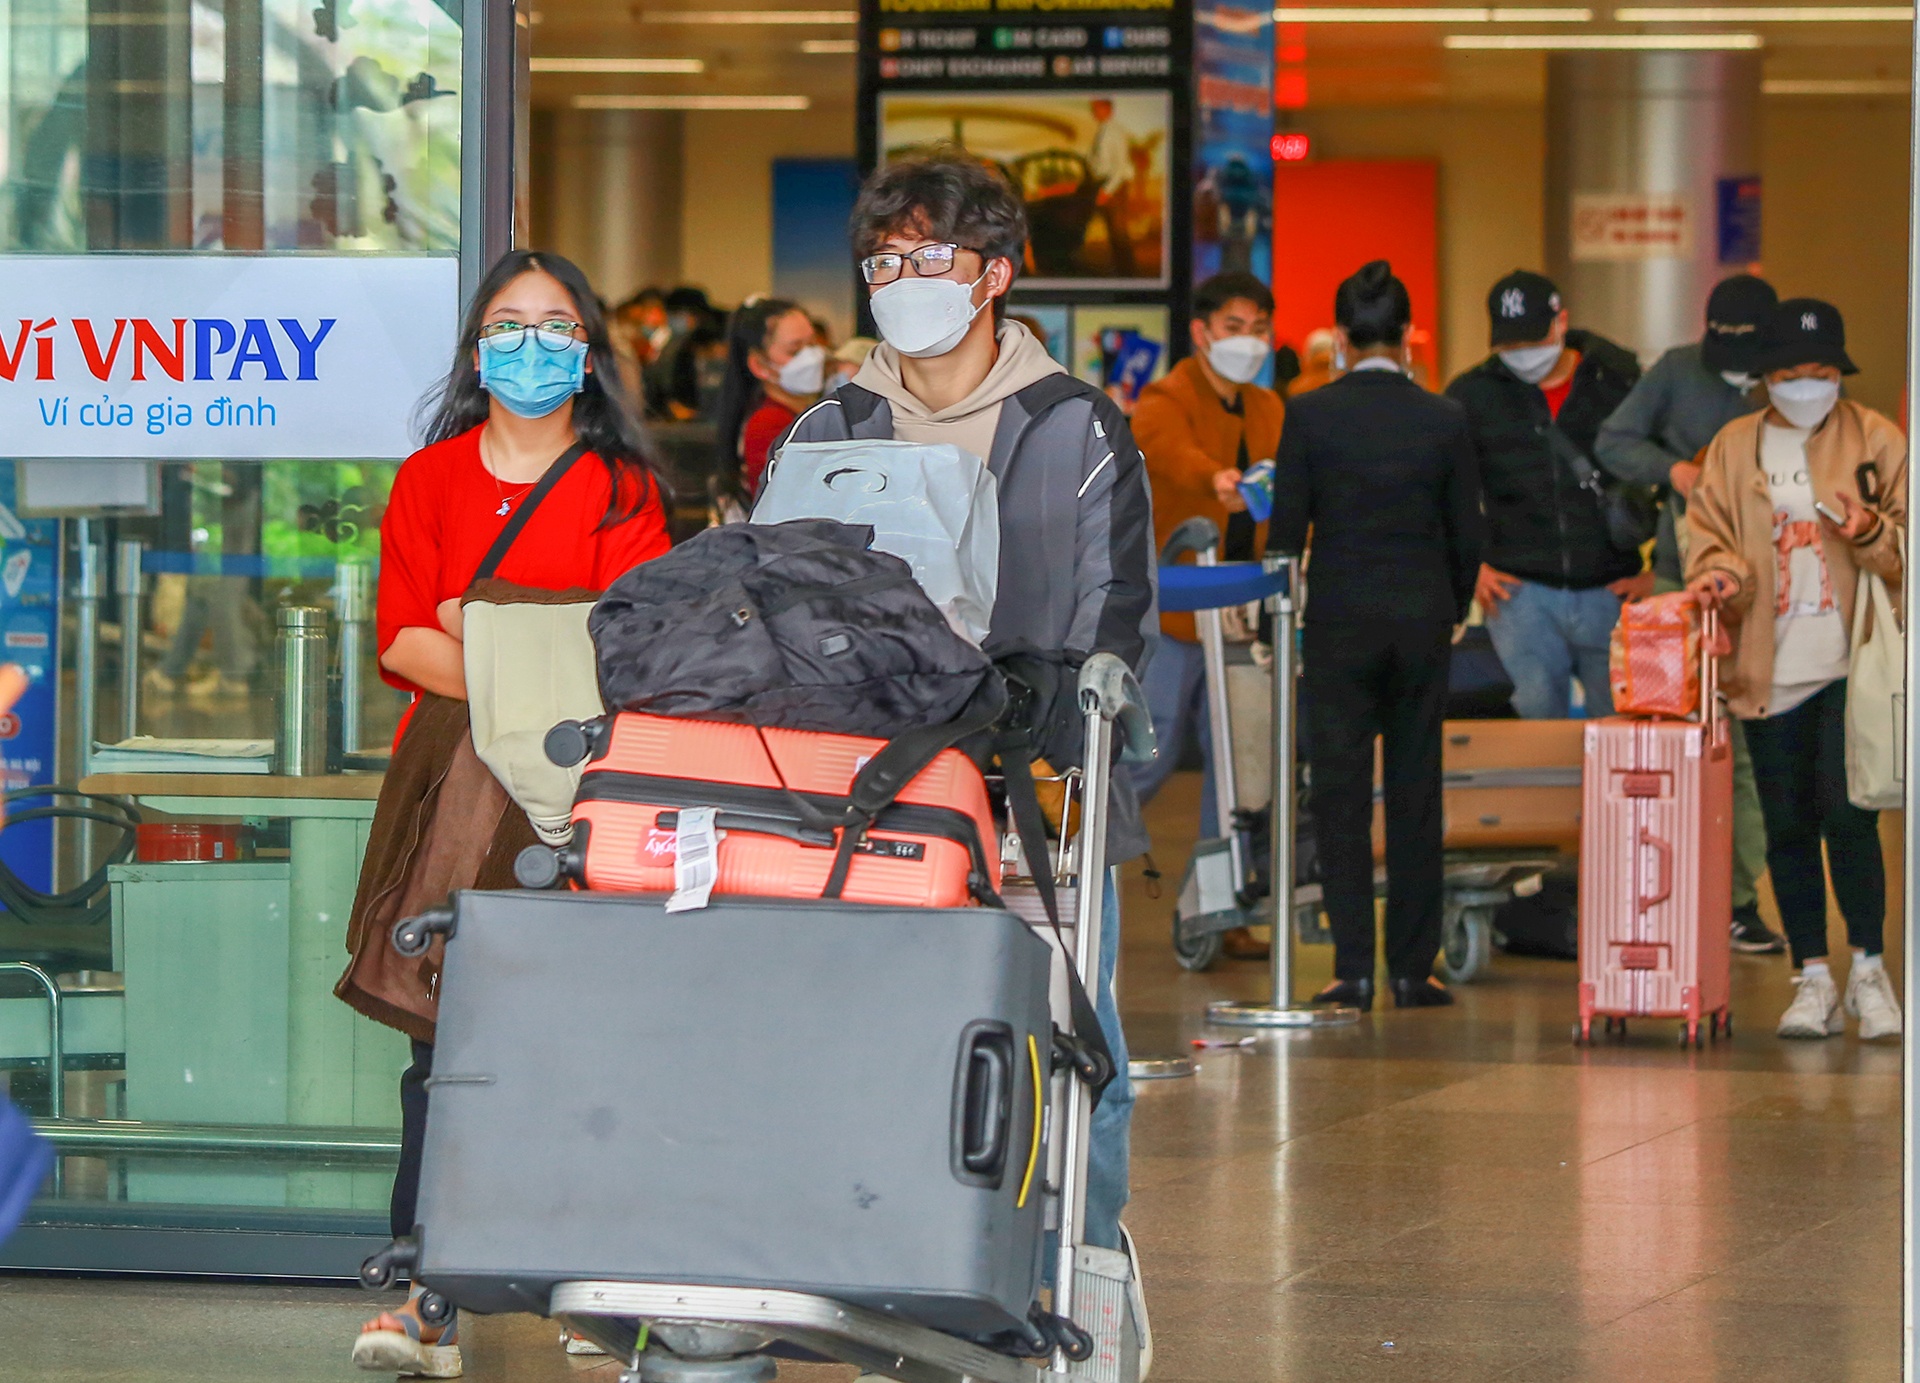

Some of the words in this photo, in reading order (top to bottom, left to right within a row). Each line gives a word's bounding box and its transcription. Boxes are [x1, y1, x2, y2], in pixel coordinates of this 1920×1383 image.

[71, 317, 338, 383] VNPAY
[38, 397, 68, 427] Ví
[79, 393, 134, 427] của
[145, 397, 192, 435] gia
[205, 396, 277, 427] đình
